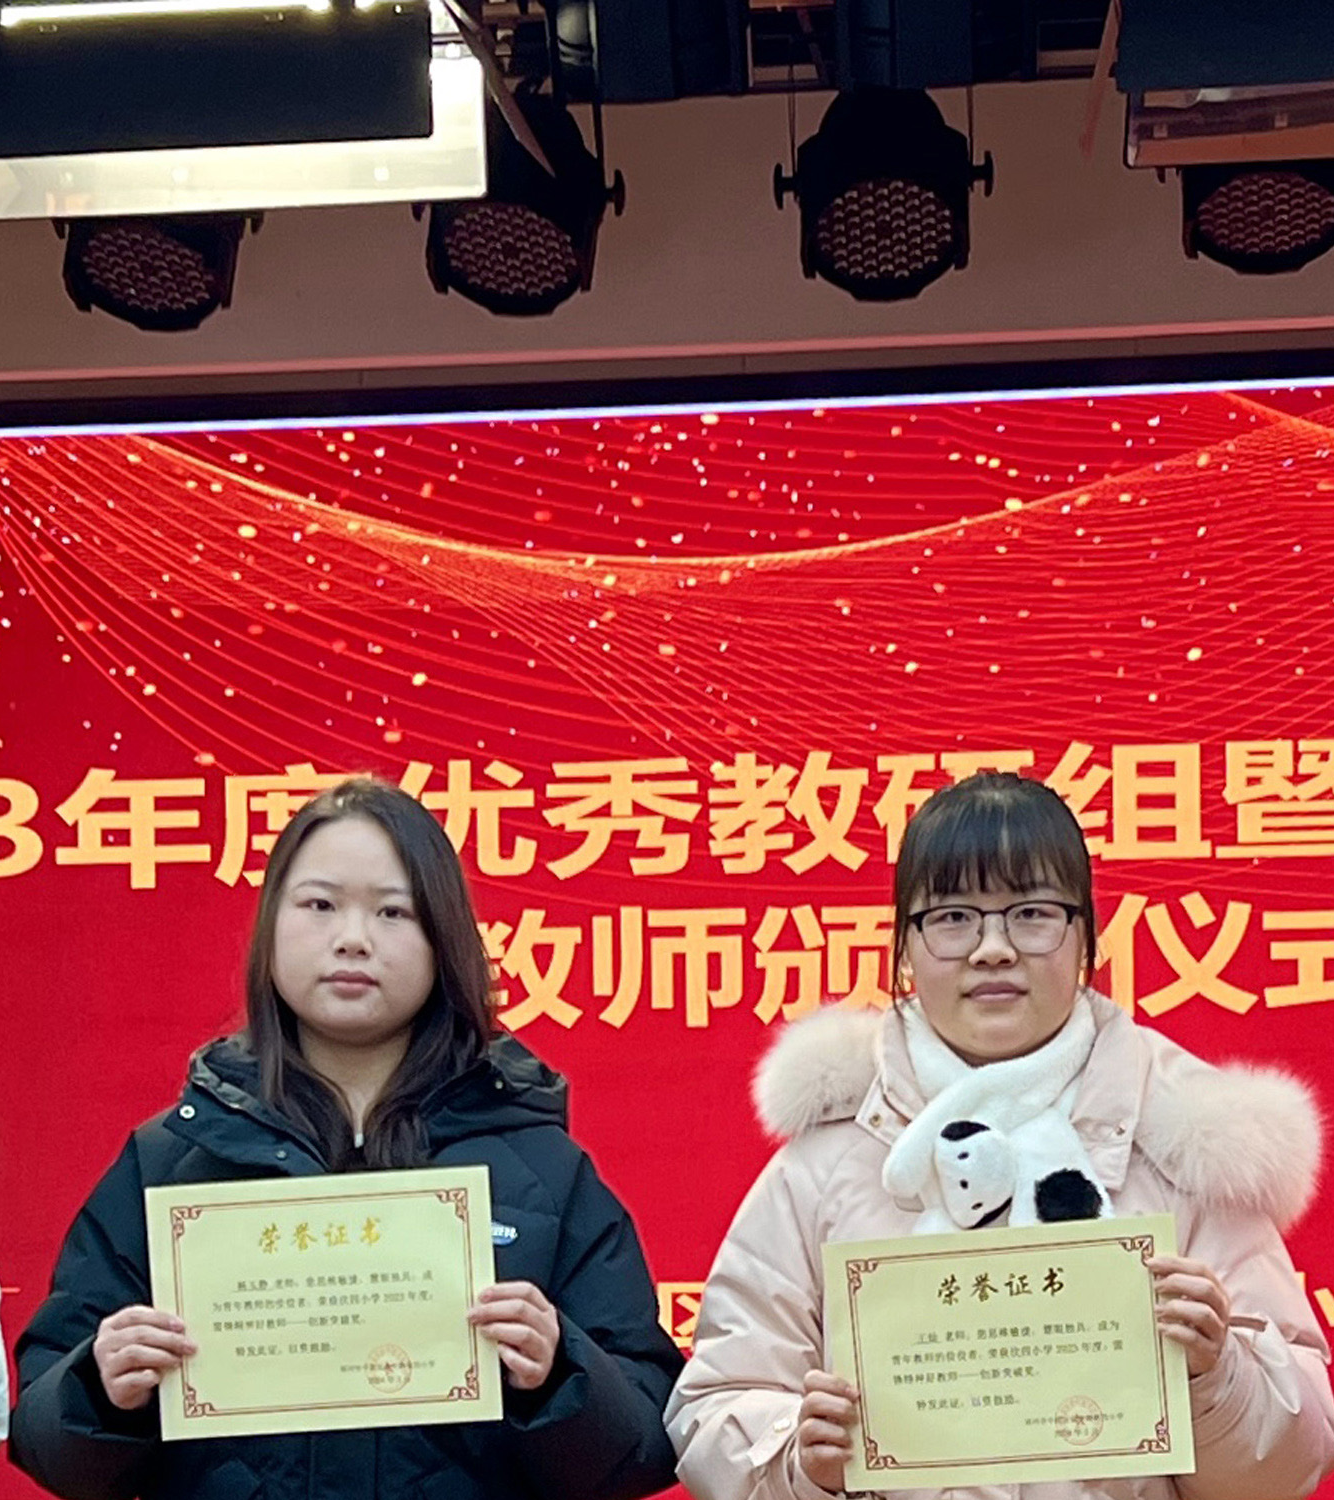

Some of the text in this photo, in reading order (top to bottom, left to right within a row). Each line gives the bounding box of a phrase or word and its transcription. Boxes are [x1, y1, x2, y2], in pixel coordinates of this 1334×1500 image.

[257, 1217, 381, 1254] 荣誉证书
[937, 1267, 1065, 1306] 荣誉证书
